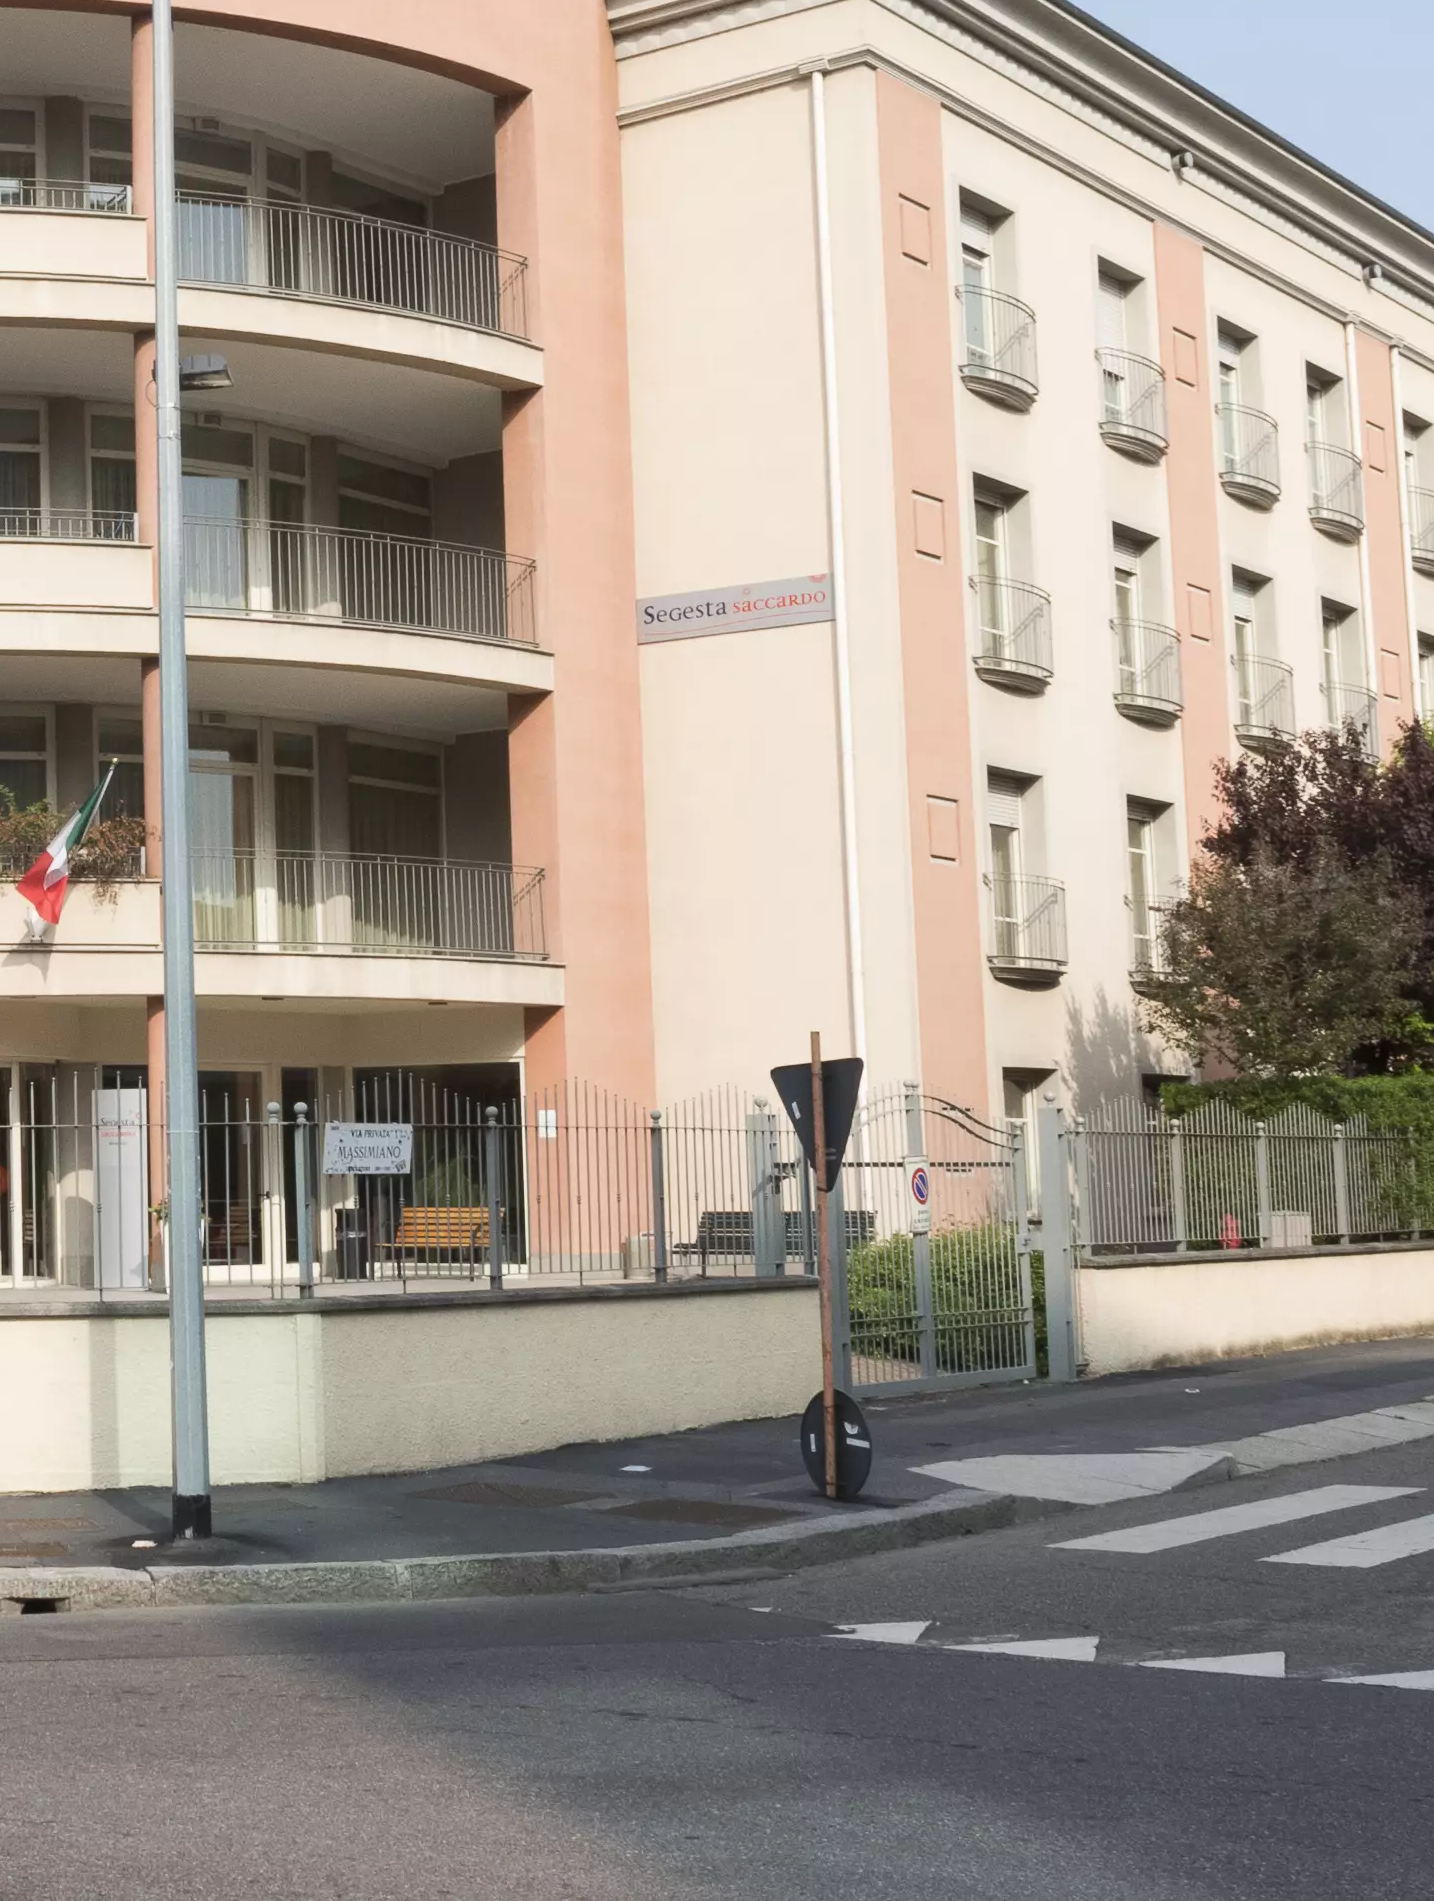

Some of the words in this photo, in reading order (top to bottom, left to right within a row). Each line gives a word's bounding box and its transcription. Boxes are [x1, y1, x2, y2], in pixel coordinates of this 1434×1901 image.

[350, 1129, 362, 1138] VIA
[364, 1129, 390, 1138] PRIVATA
[338, 1146, 401, 1159] MASSIMIANO
